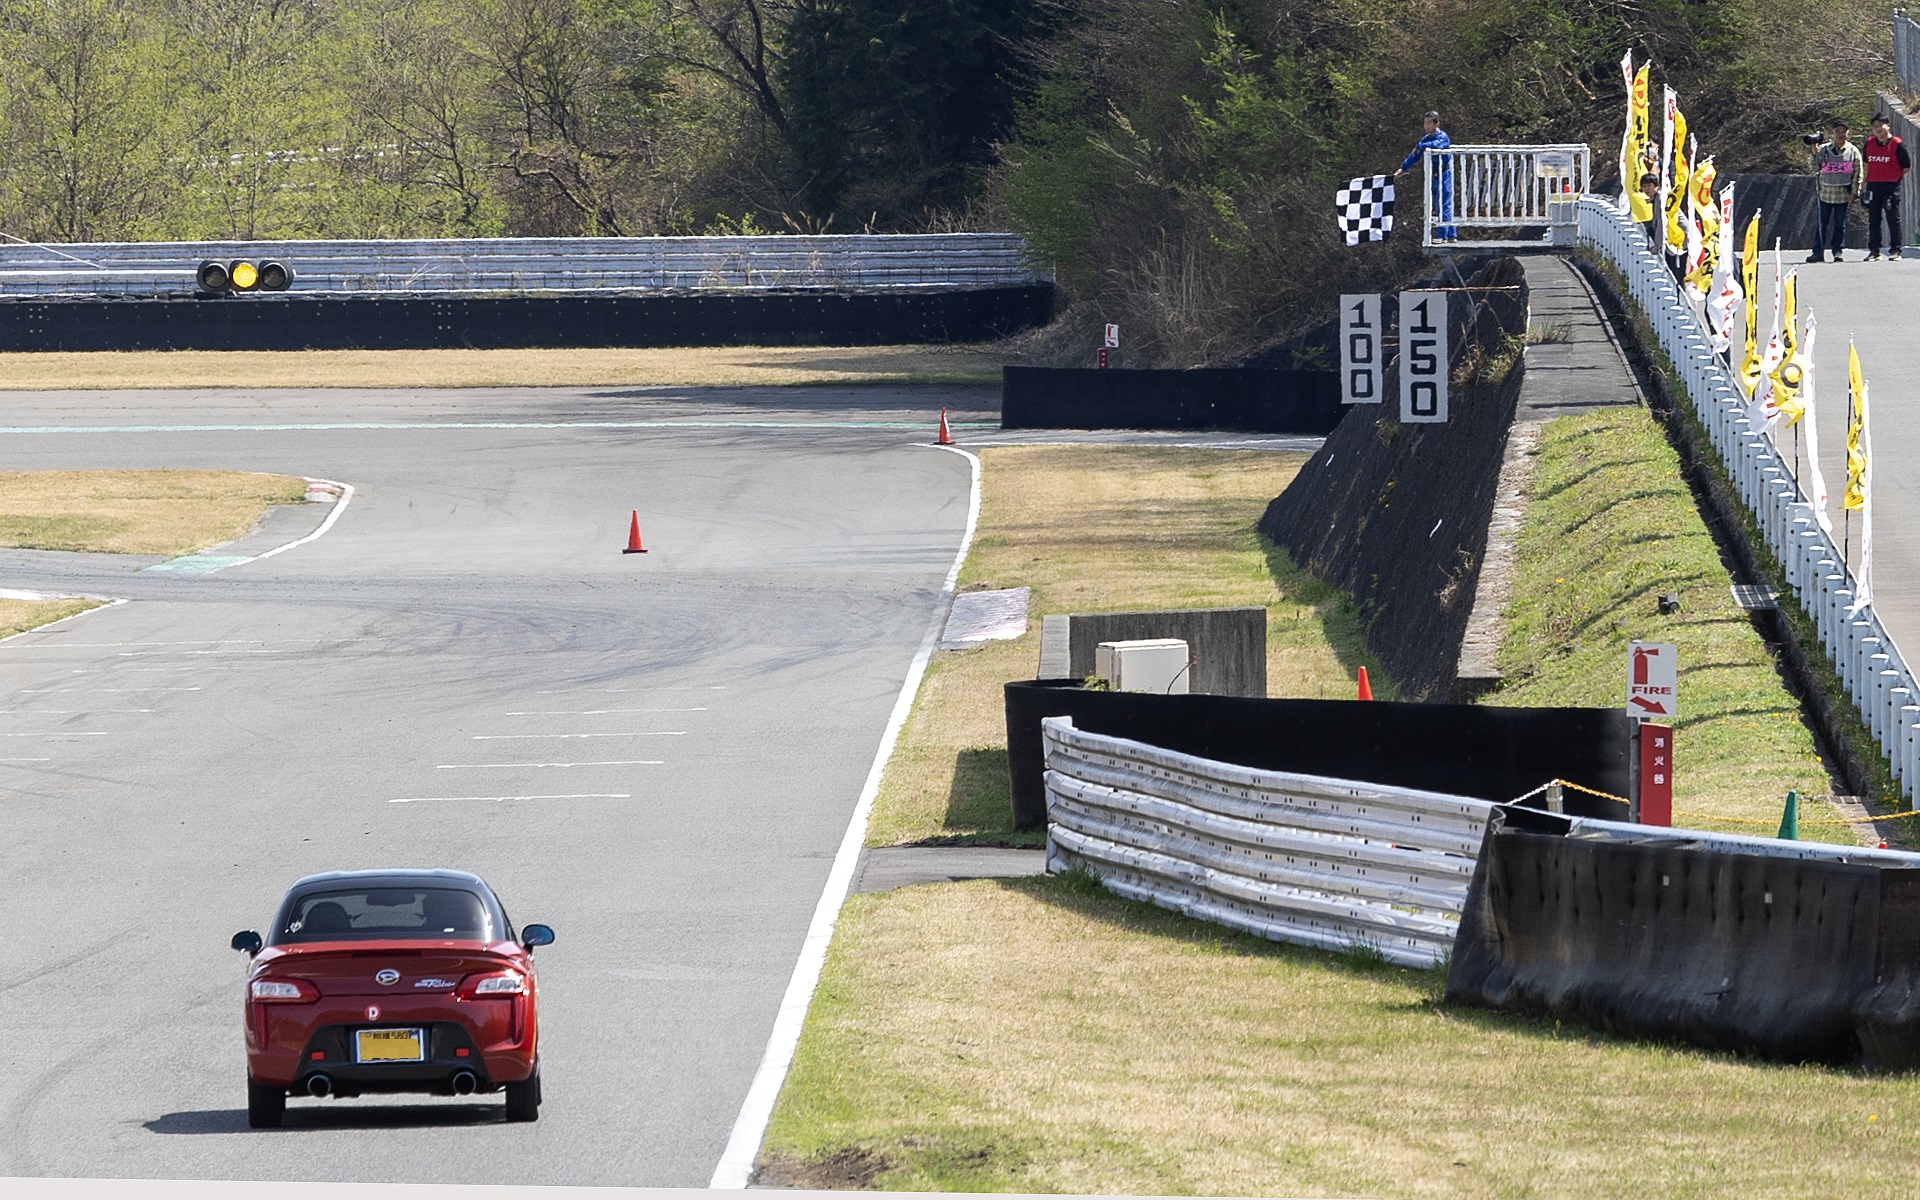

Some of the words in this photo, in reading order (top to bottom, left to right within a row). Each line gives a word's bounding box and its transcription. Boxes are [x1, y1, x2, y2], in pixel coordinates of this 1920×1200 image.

[1868, 155, 1890, 163] STAFF
[1350, 299, 1373, 398] 100
[1410, 298, 1437, 416] 150
[1631, 686, 1672, 695] FIRE
